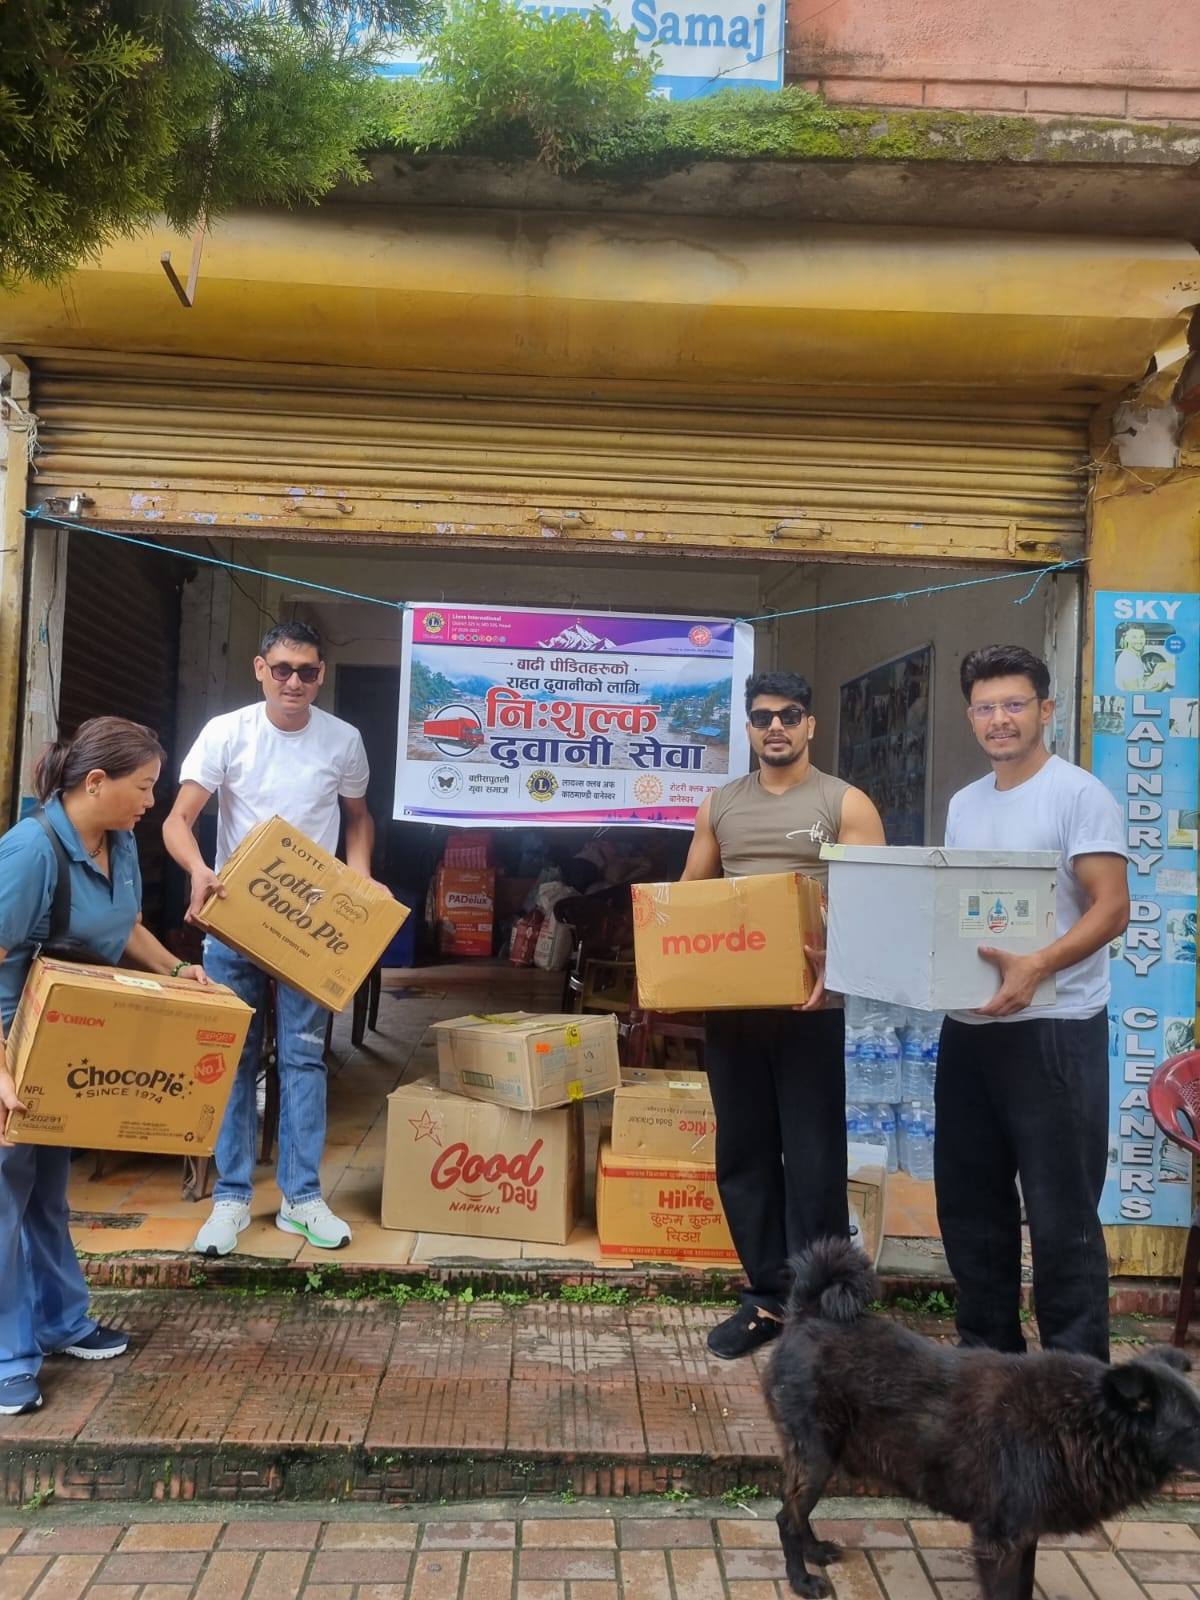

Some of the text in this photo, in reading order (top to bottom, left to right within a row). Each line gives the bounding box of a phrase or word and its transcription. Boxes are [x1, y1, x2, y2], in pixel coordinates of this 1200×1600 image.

[631, 0, 766, 62] Samaj
[1113, 599, 1181, 620] SKY
[517, 656, 545, 671] बाढी
[506, 677, 540, 690] राहत
[607, 680, 640, 695] लागि
[629, 735, 706, 770] सेवा
[486, 786, 509, 794] समाज
[1127, 694, 1165, 875] LAUNDRY
[291, 846, 327, 872] LOTTE
[262, 856, 323, 905] Lotte
[248, 877, 349, 955] Choco Pie
[662, 923, 767, 956] morde
[1124, 900, 1162, 976] DRY
[63, 1013, 106, 1028] ORION
[24, 1085, 45, 1096] NPL
[67, 1065, 184, 1097] ChocoPie
[87, 1087, 163, 1105] SINCE 1974
[656, 1118, 673, 1127] Soda
[1119, 1007, 1158, 1219] CLEANERS
[679, 1120, 707, 1136] Rice
[431, 1138, 544, 1190] Good
[449, 1201, 501, 1215] NAPKINS
[498, 1181, 538, 1212] Day
[658, 1188, 714, 1211] Hilife
